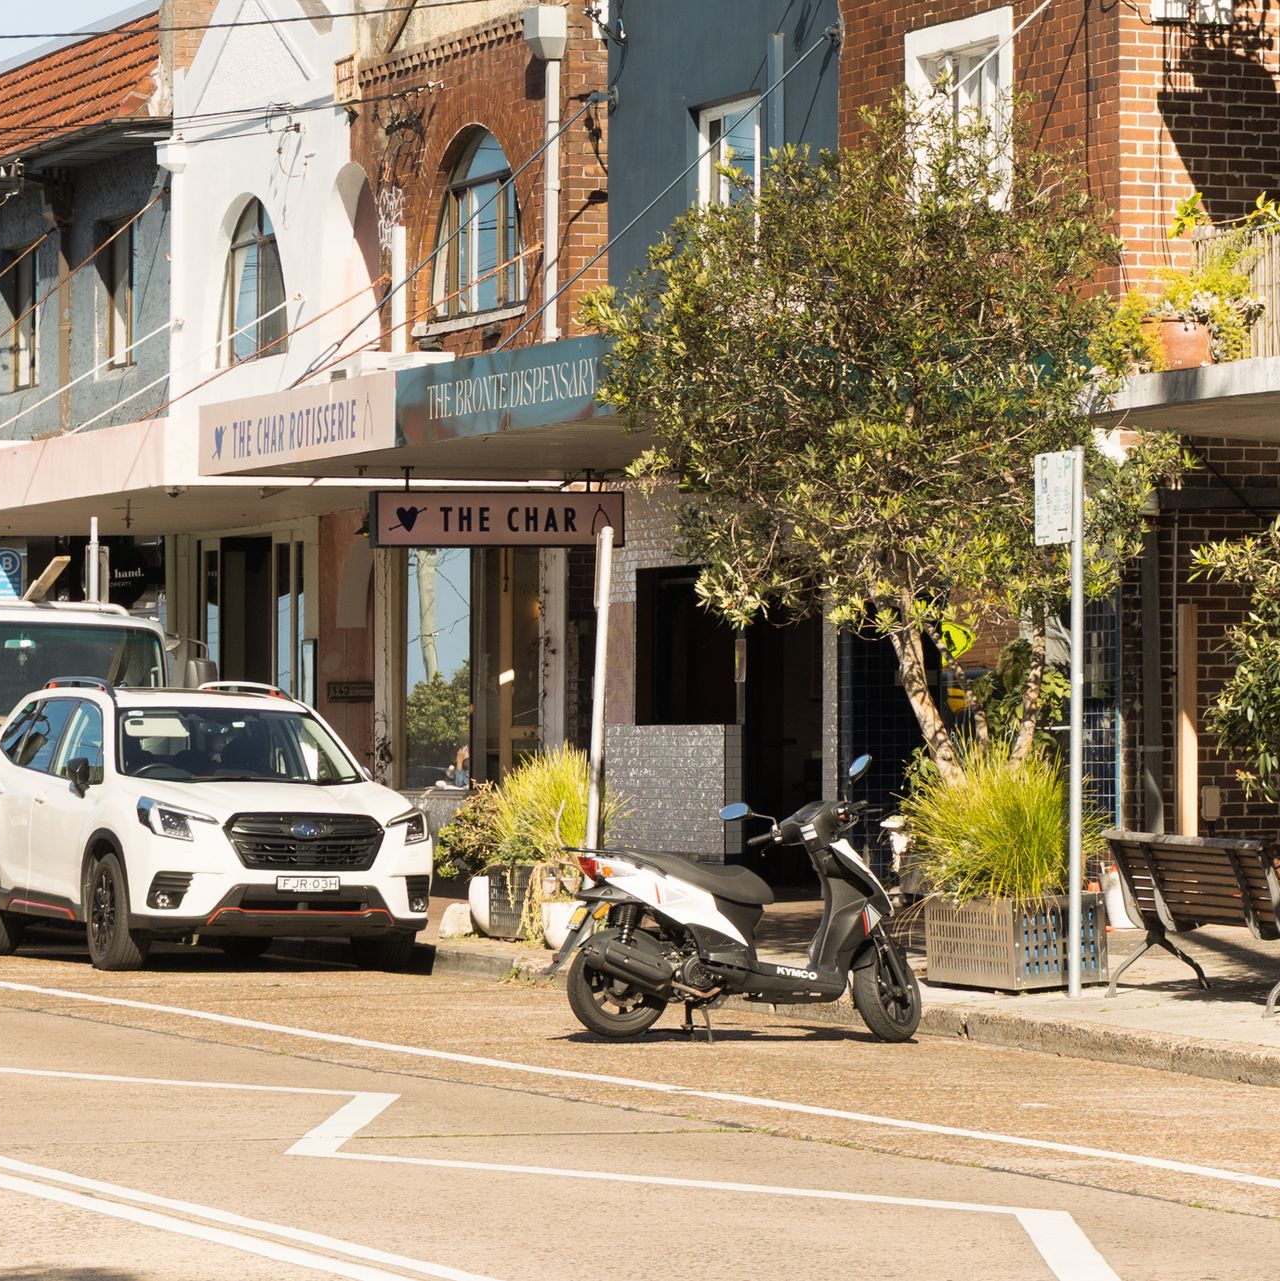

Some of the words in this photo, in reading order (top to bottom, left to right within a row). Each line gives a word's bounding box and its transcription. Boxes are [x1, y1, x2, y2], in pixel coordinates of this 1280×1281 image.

[427, 382, 453, 420] THE
[455, 373, 508, 416] BRONTE
[232, 422, 251, 459] THE
[256, 415, 285, 455] CHAR
[289, 399, 357, 449] ROTISSERIE
[439, 507, 490, 532] THE
[507, 507, 578, 532] CHAR
[114, 568, 145, 579] hand.
[776, 966, 818, 980] KYMCO
